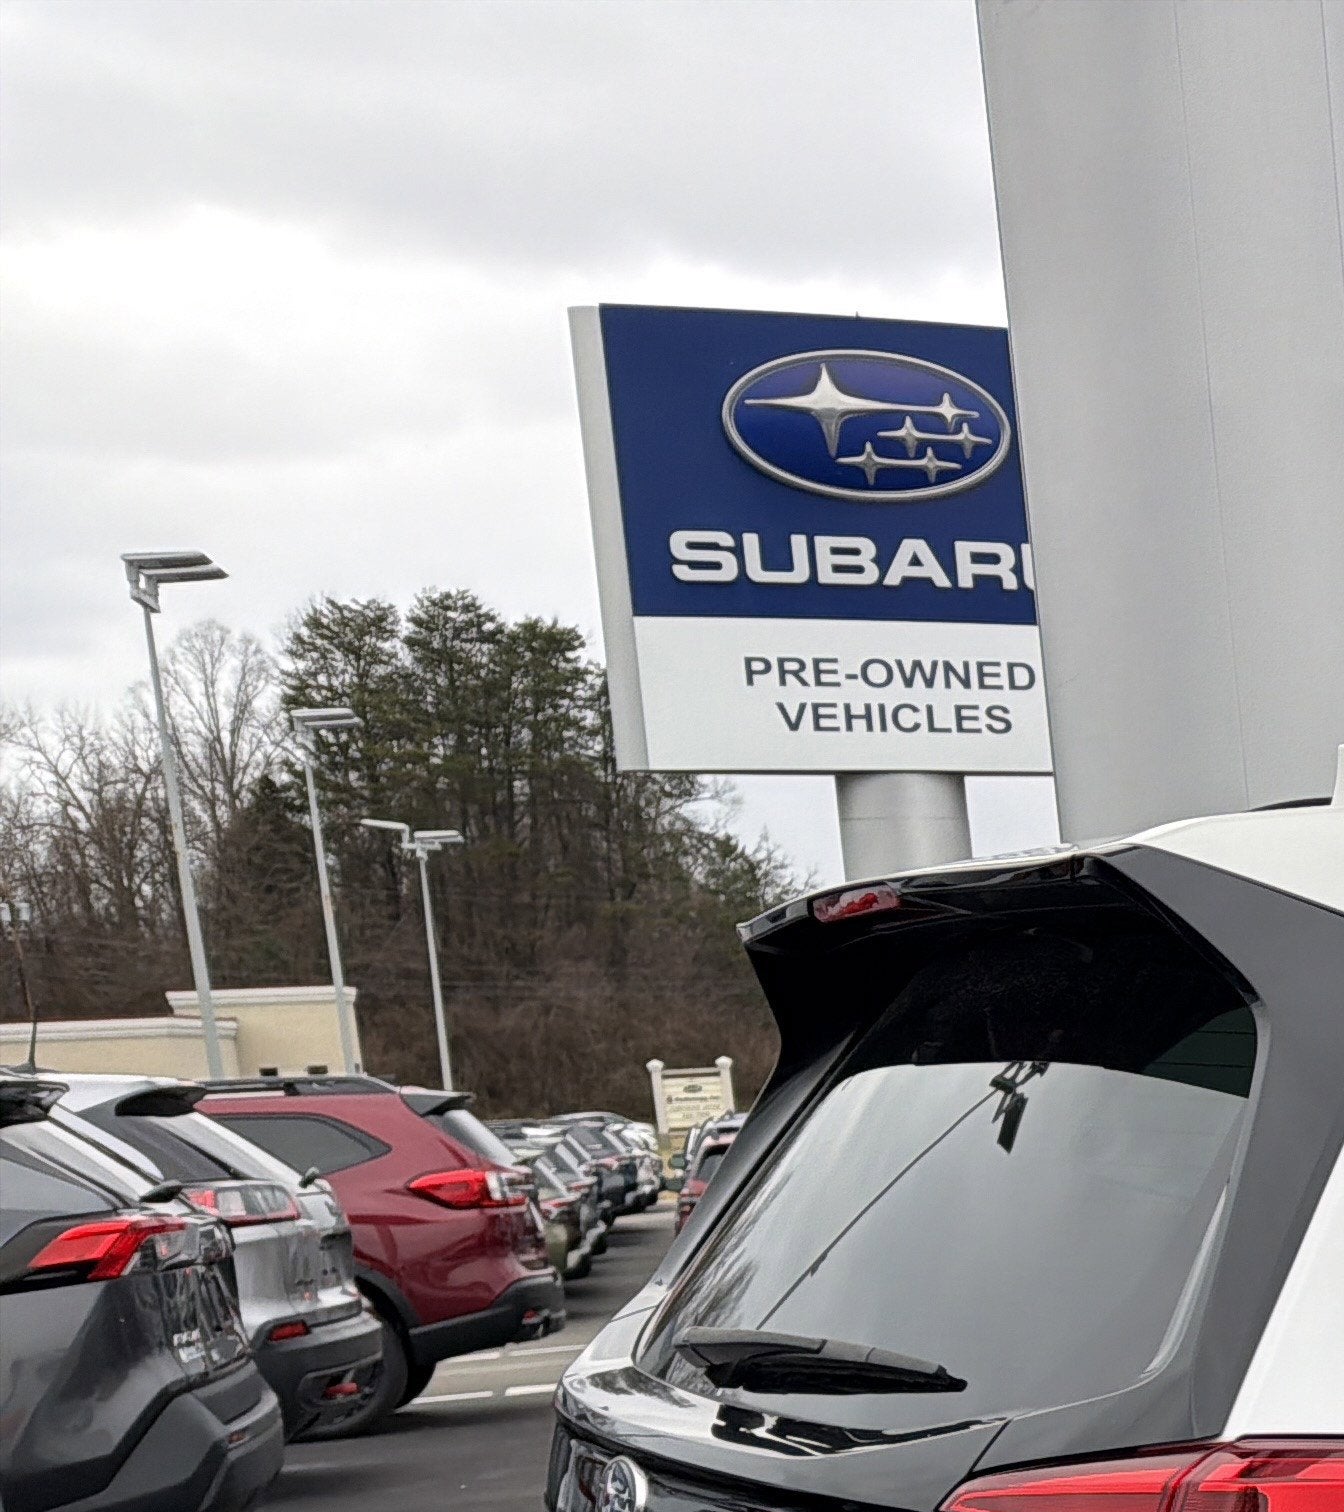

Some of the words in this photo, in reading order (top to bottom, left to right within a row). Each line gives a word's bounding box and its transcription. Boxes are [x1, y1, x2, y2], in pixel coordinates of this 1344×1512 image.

[669, 530, 1035, 591] SUBAR
[743, 655, 1036, 692] PRE-OWNED
[776, 701, 1013, 735] VEHICLES
